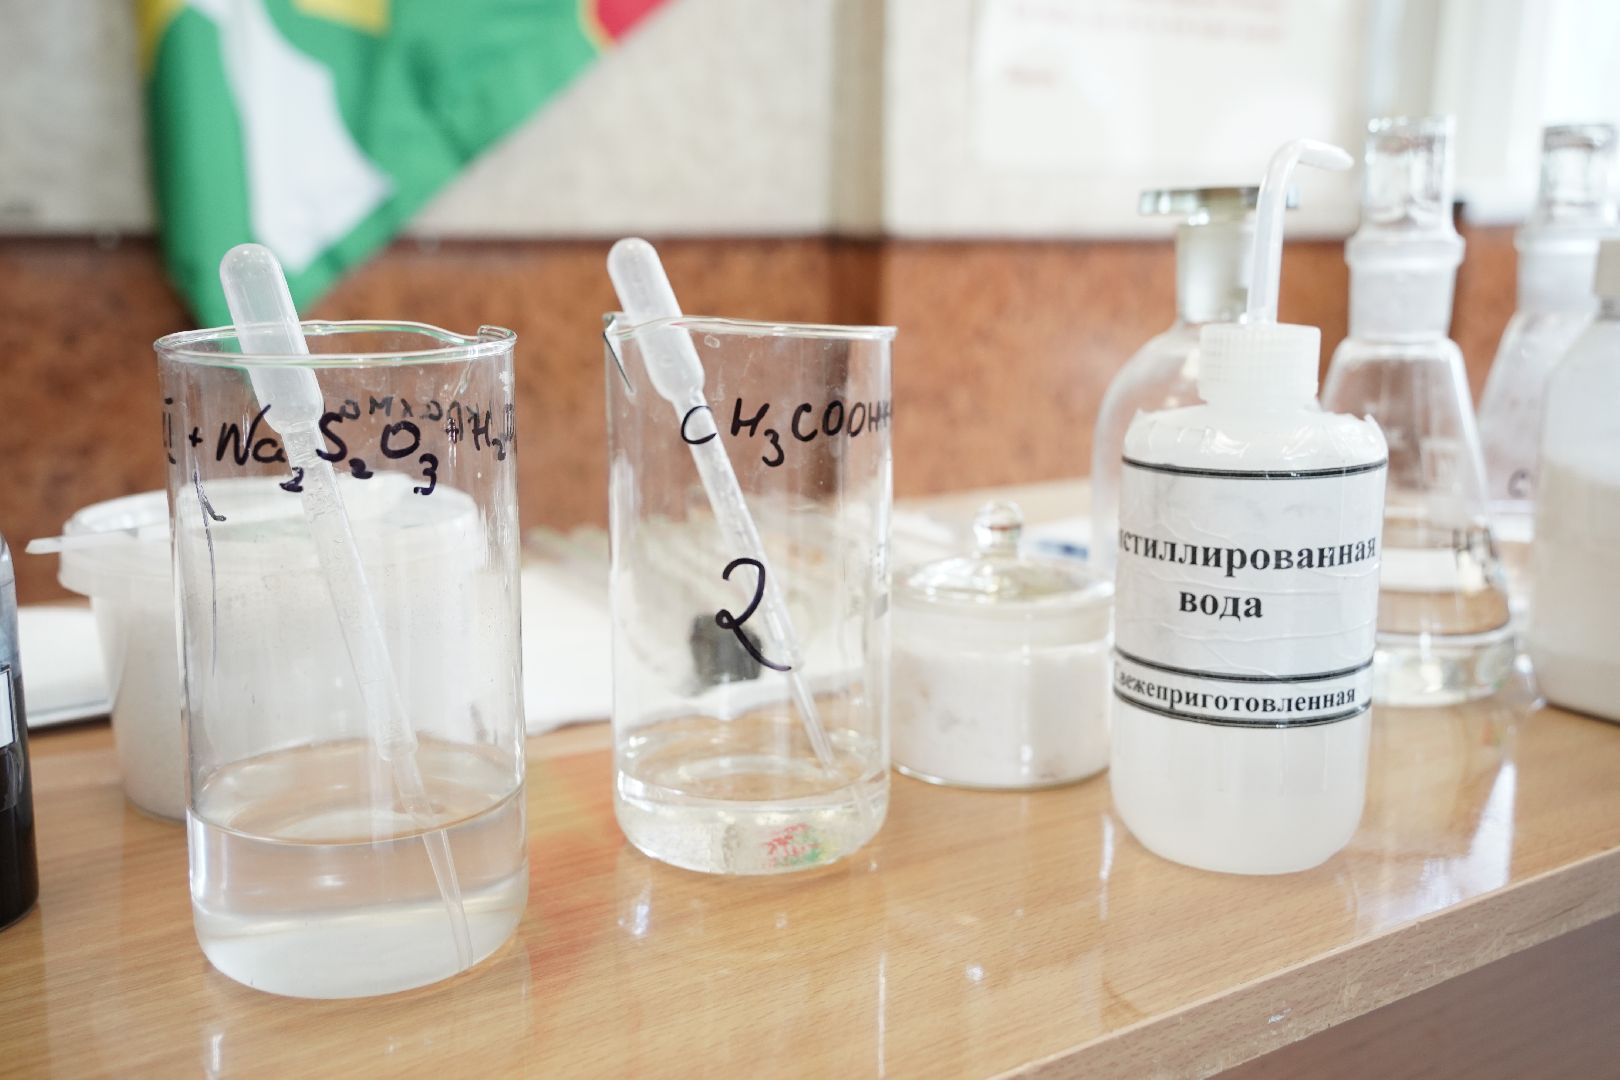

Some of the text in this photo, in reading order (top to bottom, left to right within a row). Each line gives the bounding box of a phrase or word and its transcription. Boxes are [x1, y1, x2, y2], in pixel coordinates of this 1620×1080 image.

[715, 558, 792, 671] 2
[1178, 590, 1263, 621] вода
[1117, 670, 1356, 713] вежеприготовленная
